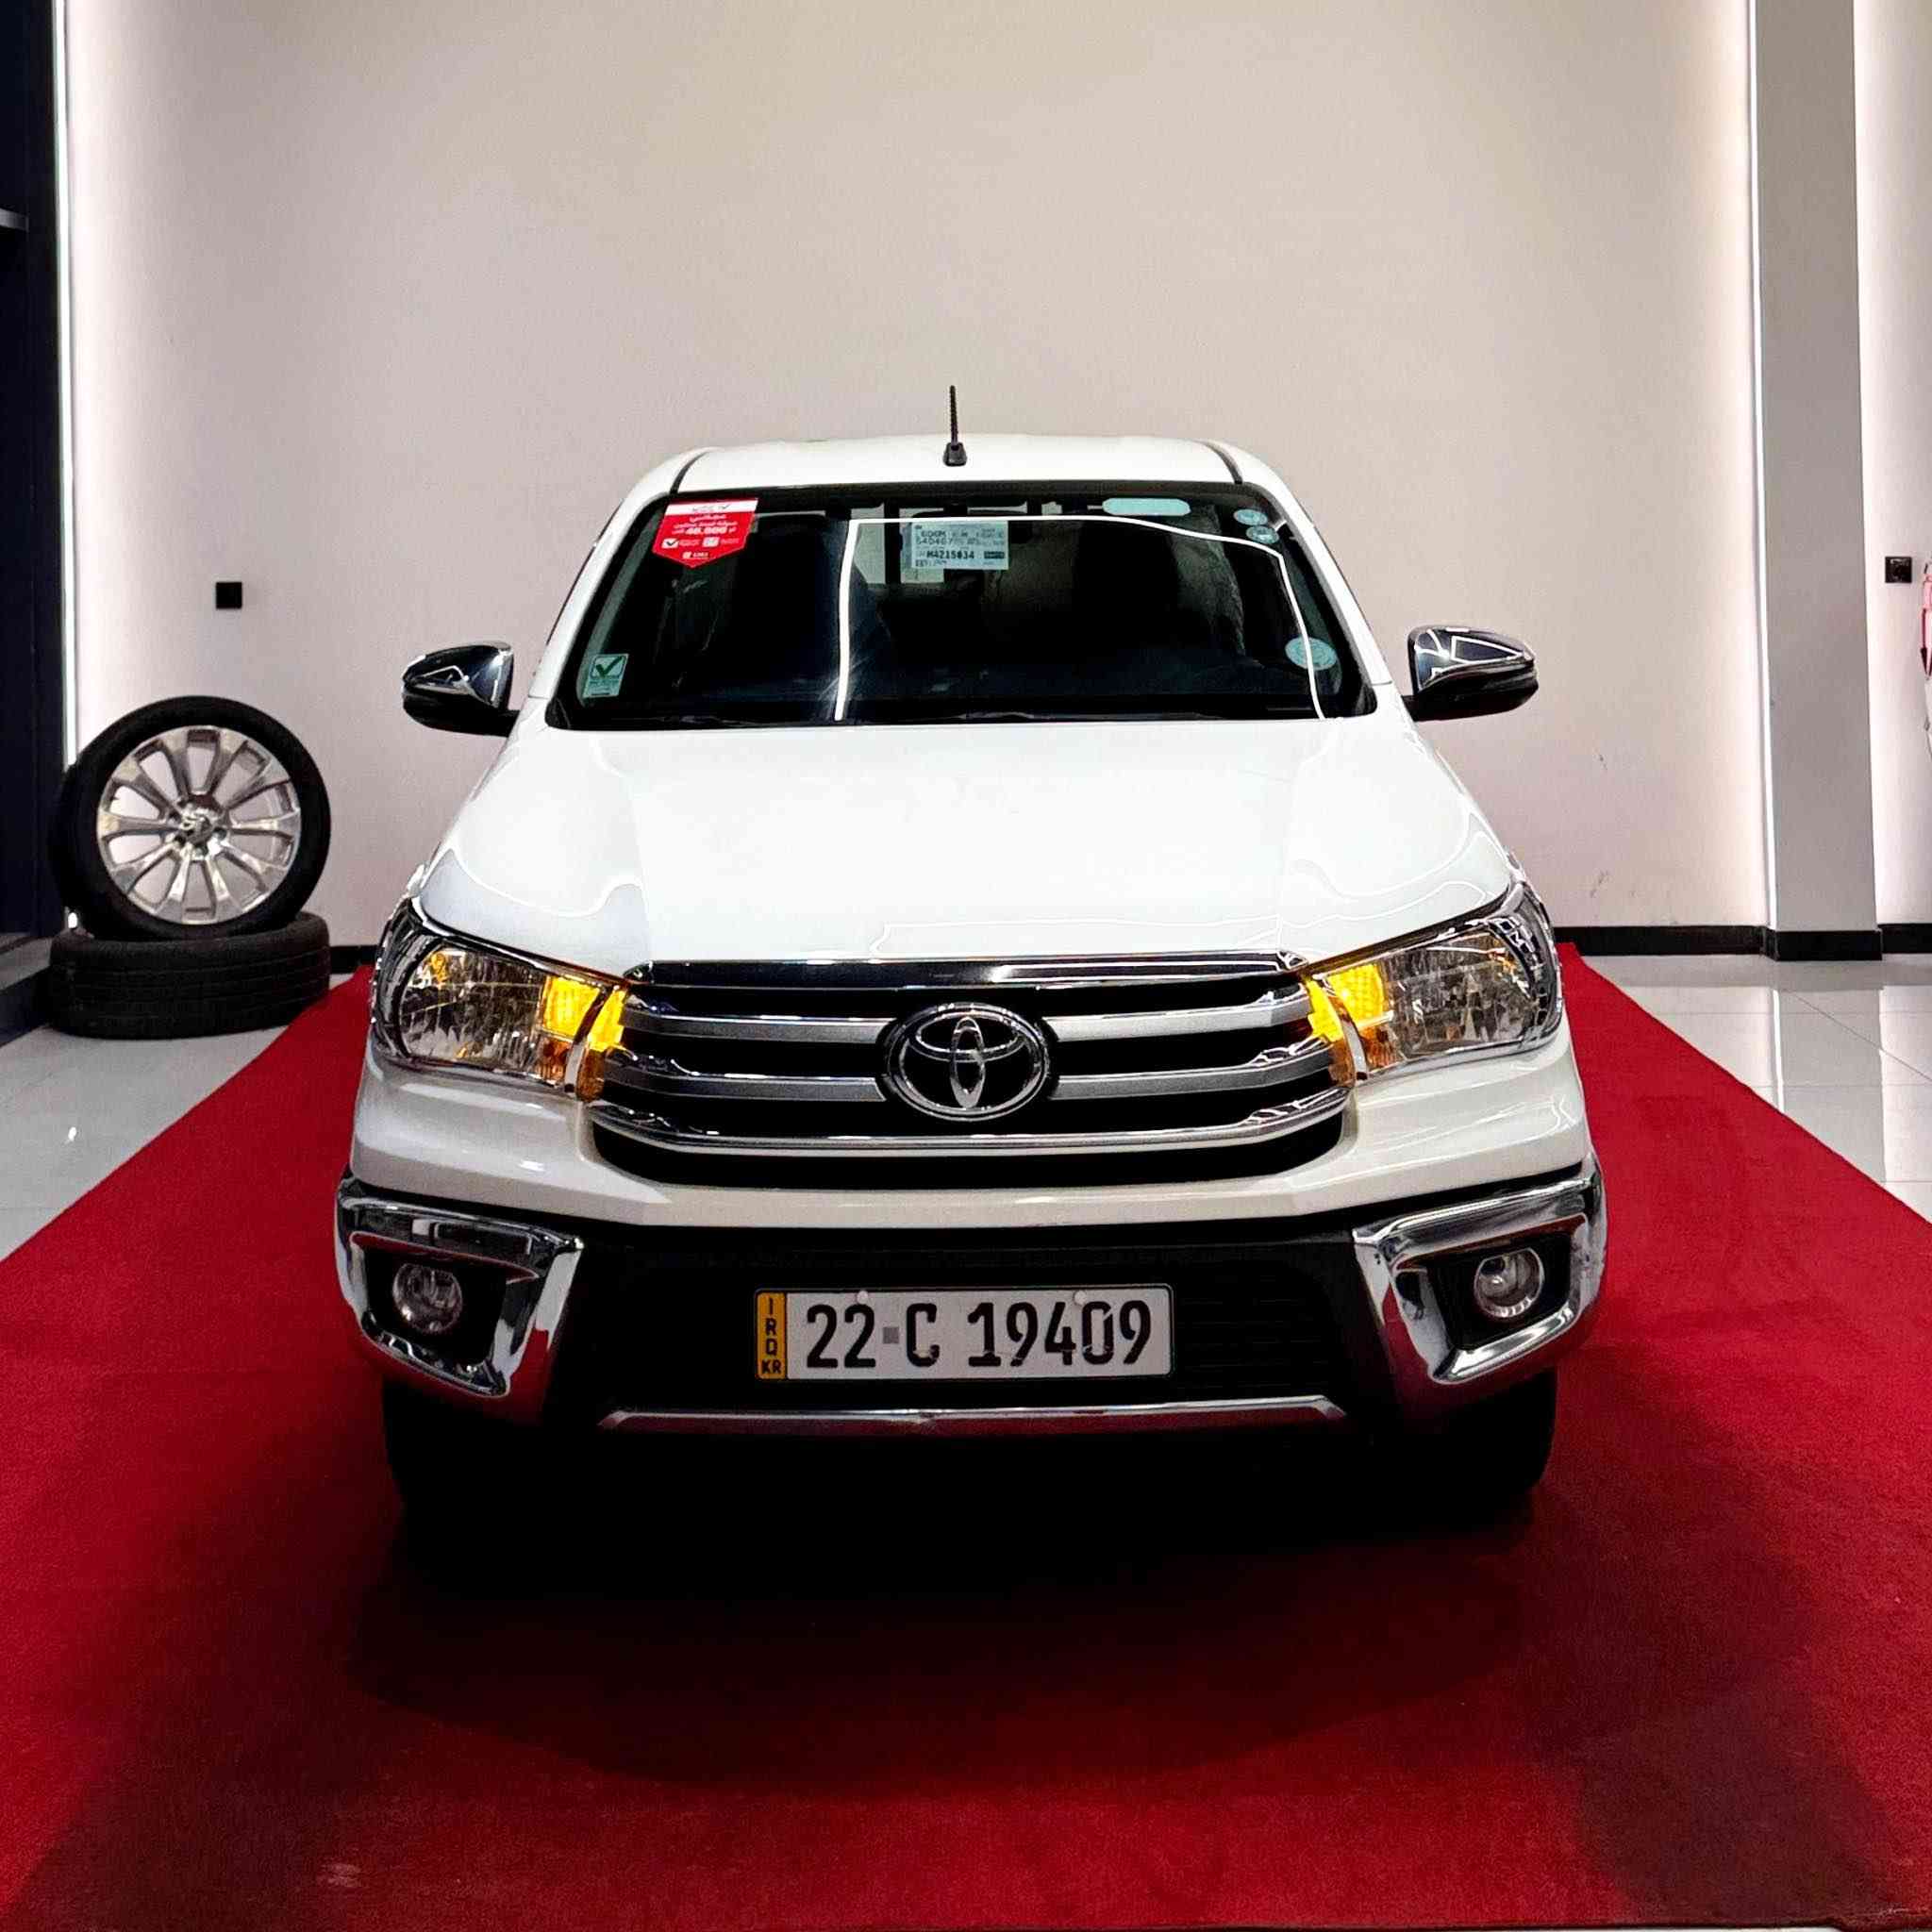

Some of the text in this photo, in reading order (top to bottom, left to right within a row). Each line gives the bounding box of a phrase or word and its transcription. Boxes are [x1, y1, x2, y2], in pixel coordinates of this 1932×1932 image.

[807, 1300, 1152, 1368] 22 C 19409
[761, 1359, 782, 1375] KR
